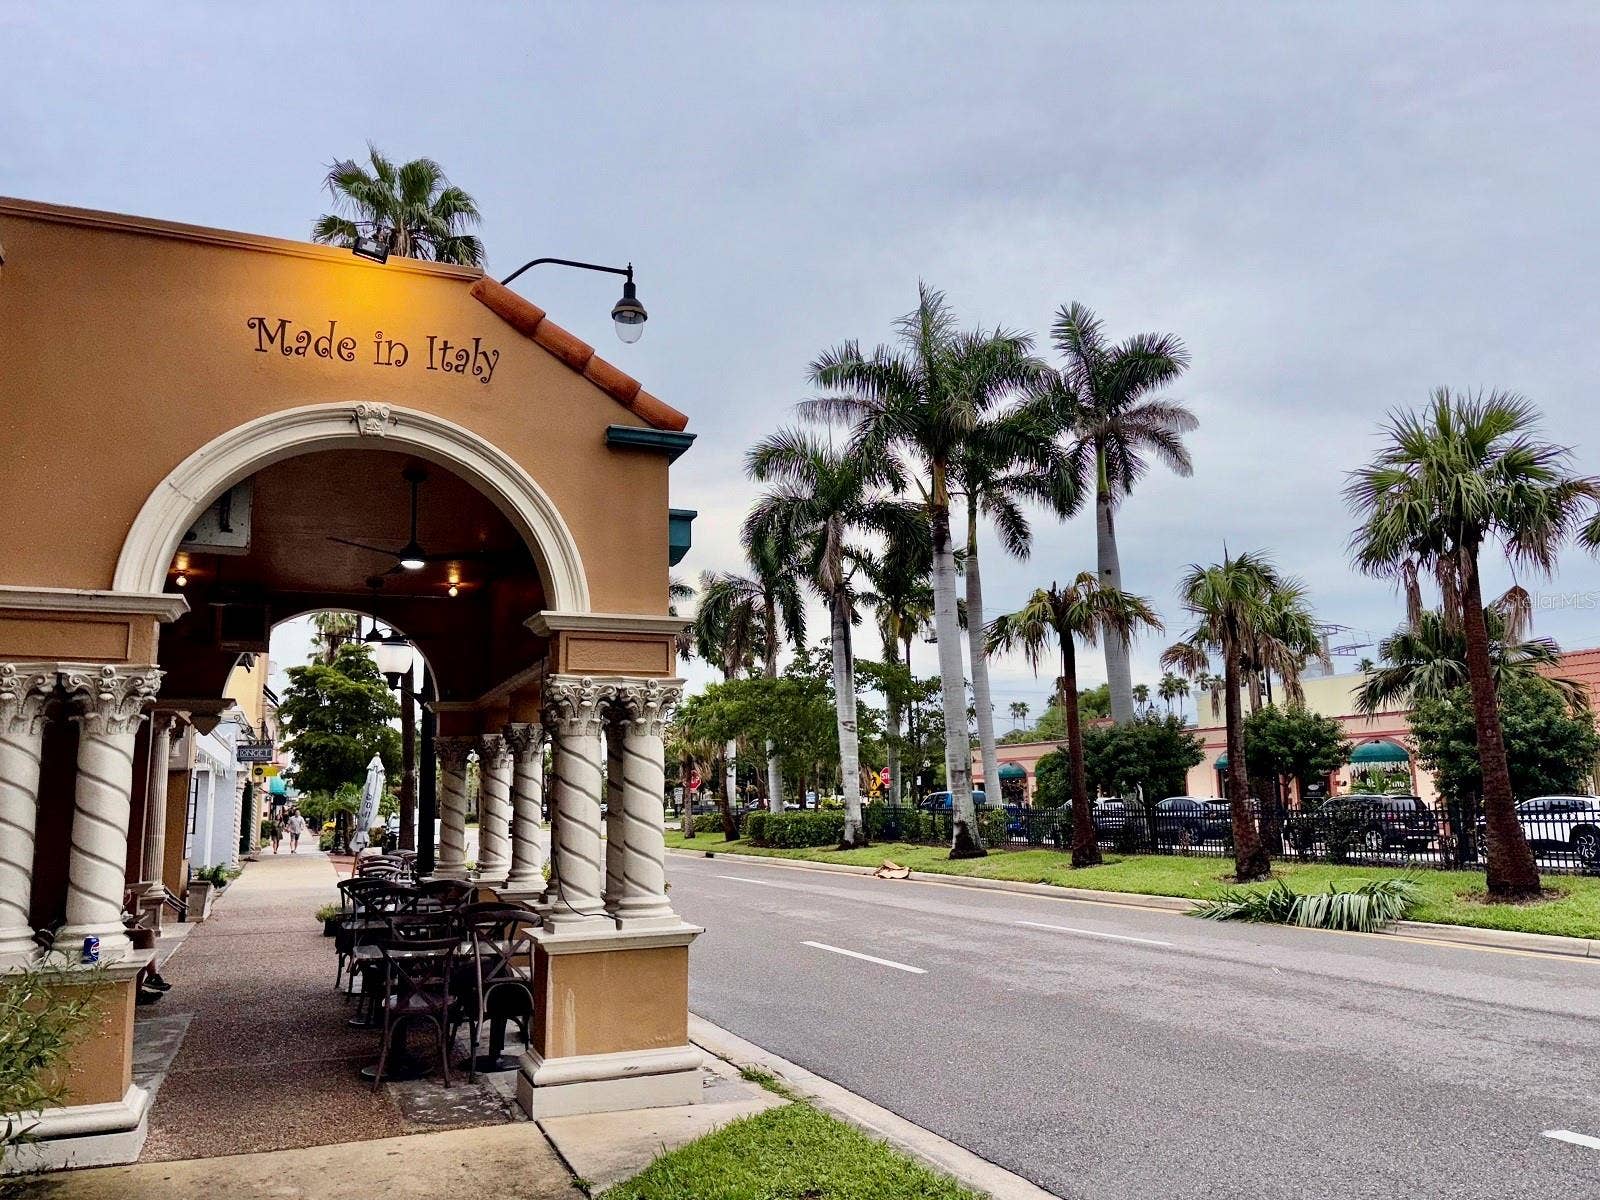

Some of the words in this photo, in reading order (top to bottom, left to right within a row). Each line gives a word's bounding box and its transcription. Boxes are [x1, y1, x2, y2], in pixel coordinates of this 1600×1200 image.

[247, 317, 357, 362] Made
[373, 331, 409, 368] in
[426, 335, 500, 384] Italy
